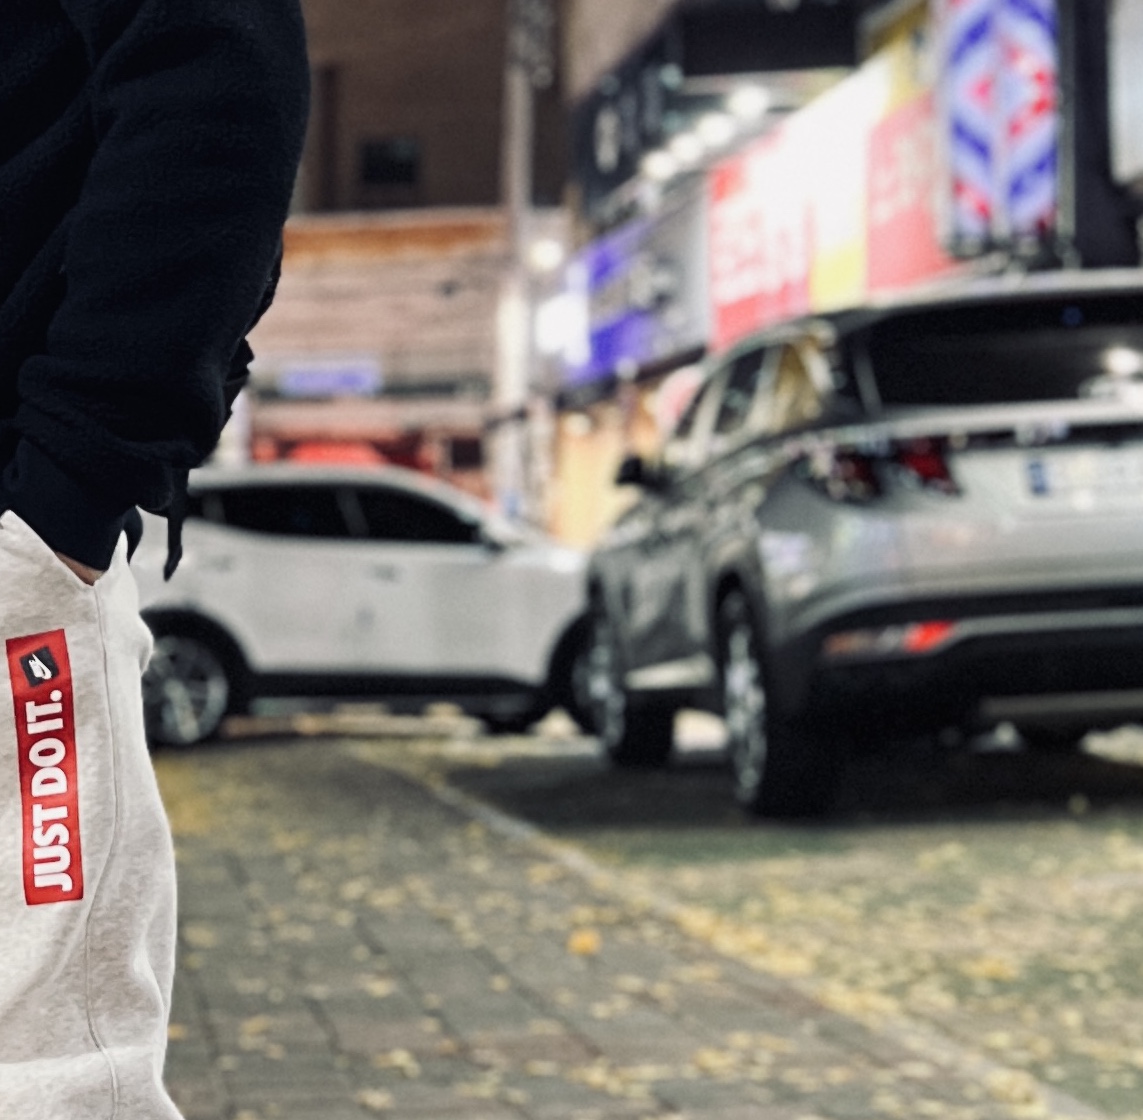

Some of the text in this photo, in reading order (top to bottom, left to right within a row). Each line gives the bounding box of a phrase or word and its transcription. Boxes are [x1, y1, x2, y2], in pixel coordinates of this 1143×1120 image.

[25, 689, 73, 892] JUST DO IT.
